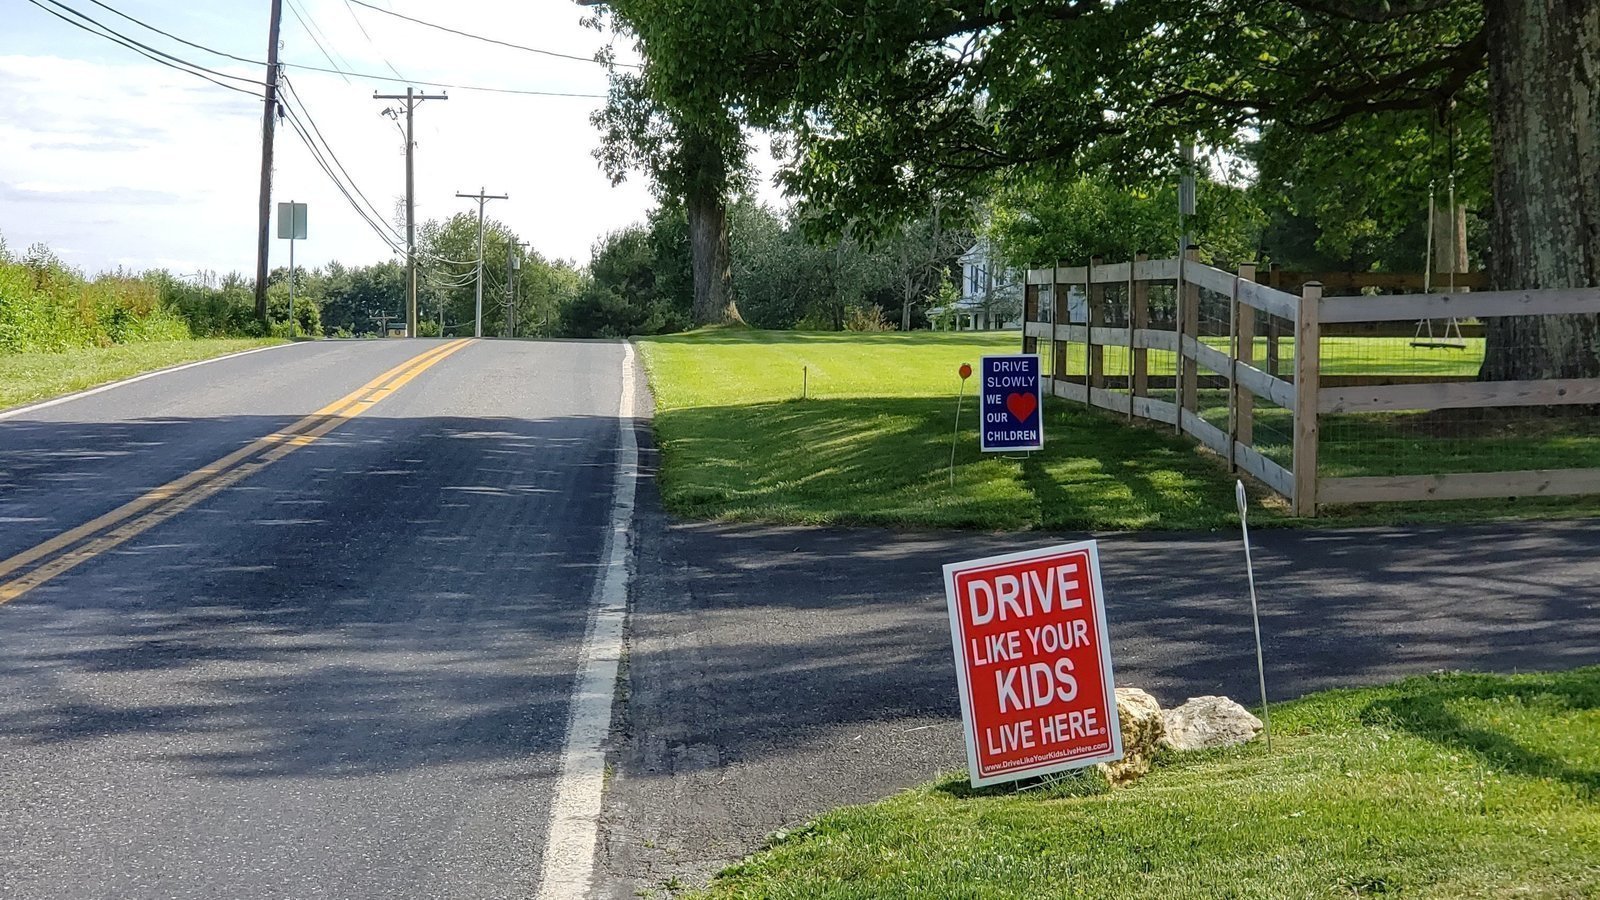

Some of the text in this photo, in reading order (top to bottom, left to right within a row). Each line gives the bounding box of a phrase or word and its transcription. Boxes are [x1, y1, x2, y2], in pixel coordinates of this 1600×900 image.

[993, 361, 1029, 372] DRIVE
[987, 376, 1035, 388] SLOWLY
[986, 394, 1002, 405] WE
[986, 412, 1008, 423] OUR
[987, 430, 1036, 441] CHILDREN
[967, 563, 1083, 626] DRIVE
[971, 619, 1090, 666] LIKE YOUR
[995, 657, 1078, 713] KIDS
[986, 720, 1035, 755] LIVE
[984, 742, 1108, 772] www.DriveLikeYourKidsLiveHere.com
